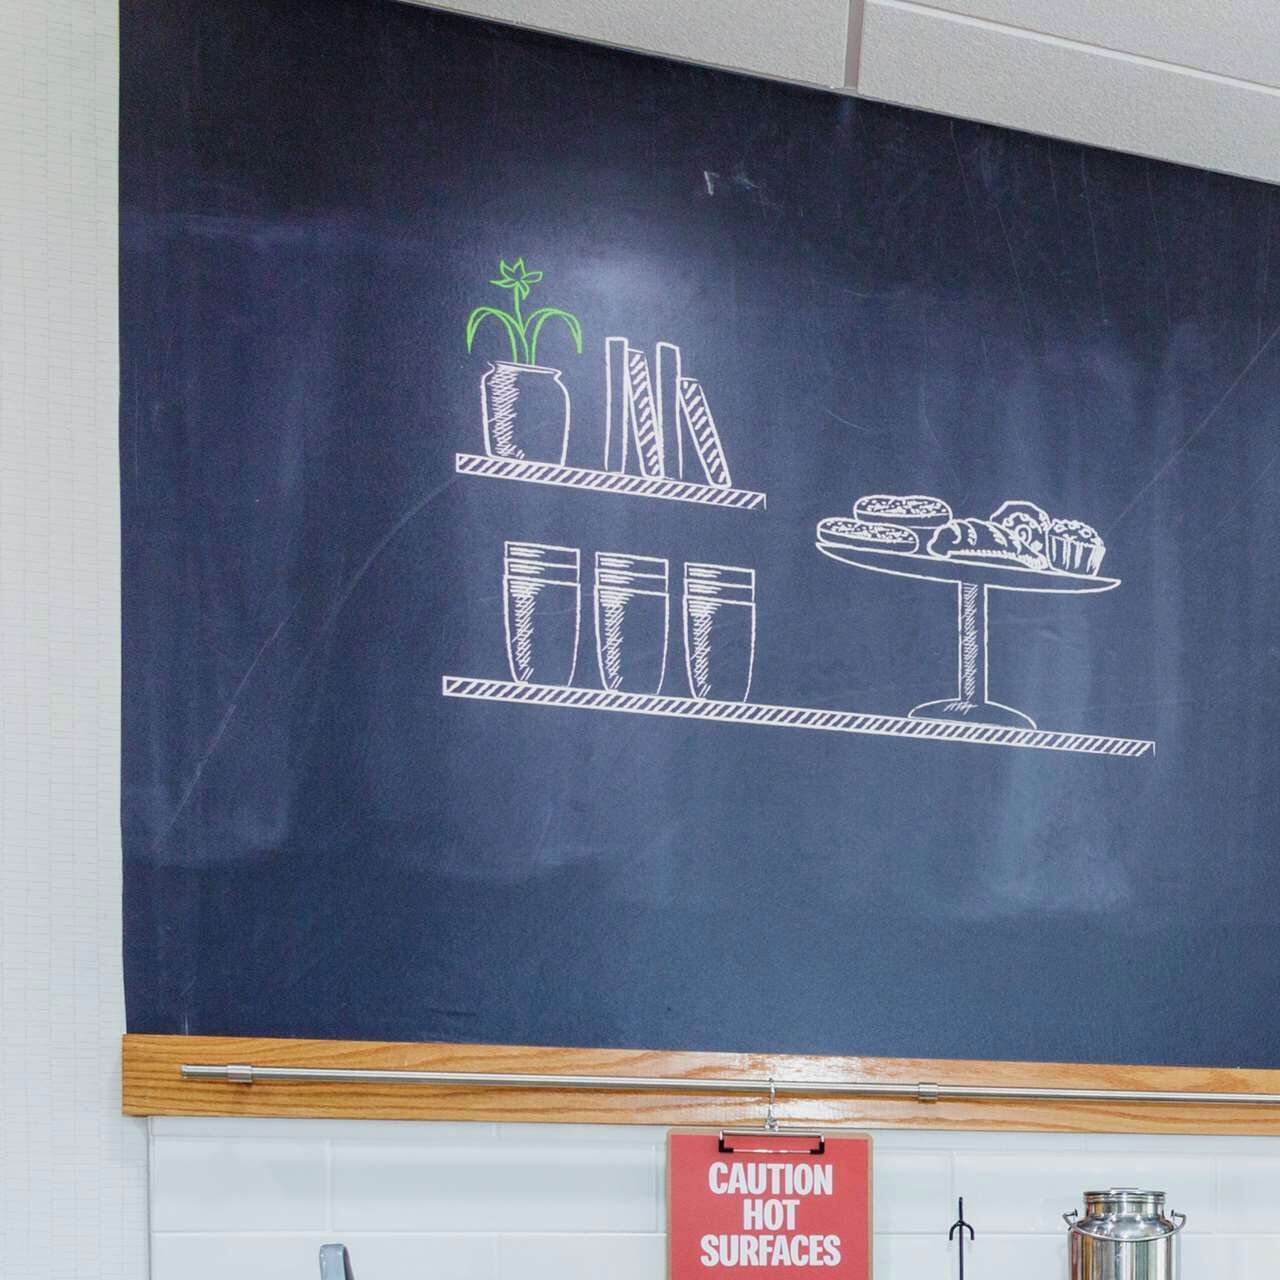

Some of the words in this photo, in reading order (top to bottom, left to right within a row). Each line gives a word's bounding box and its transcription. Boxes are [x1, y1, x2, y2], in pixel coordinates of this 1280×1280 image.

[708, 1162, 833, 1195] CAUTION
[743, 1199, 800, 1230] HOT
[700, 1234, 841, 1267] SURFACES
